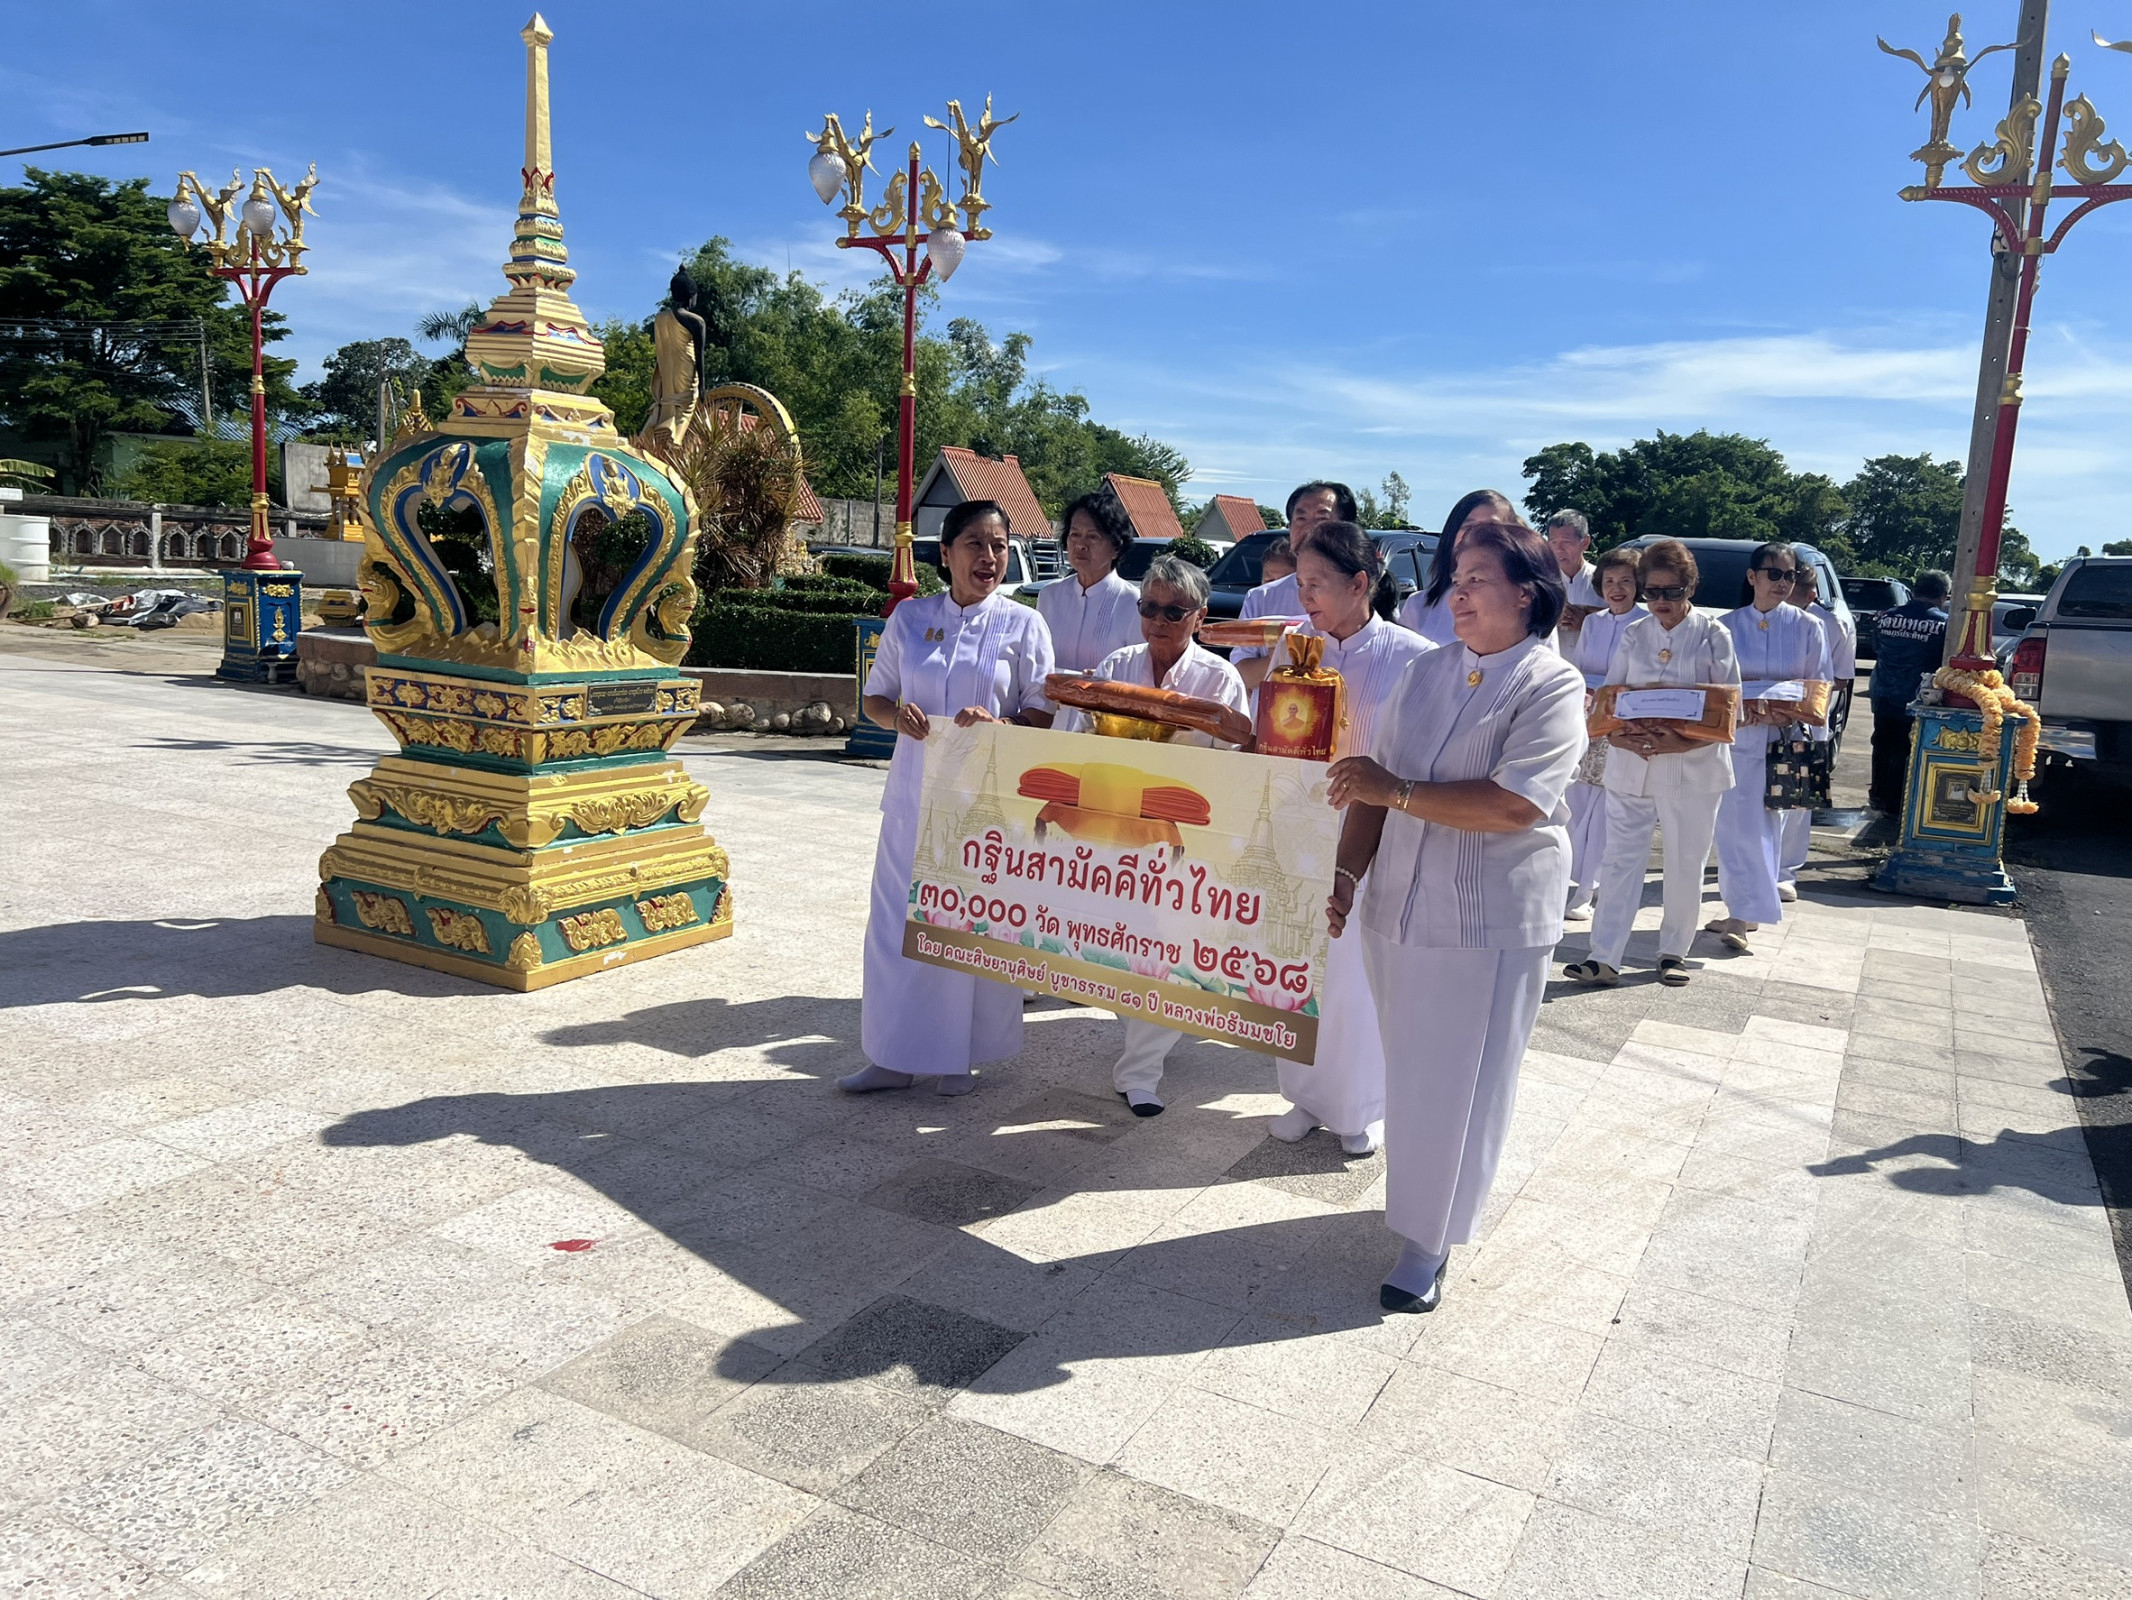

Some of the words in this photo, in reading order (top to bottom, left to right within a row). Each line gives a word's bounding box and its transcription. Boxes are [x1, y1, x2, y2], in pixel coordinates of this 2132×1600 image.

[963, 830, 1260, 925] กฐินสามัคคีทั่วไทย
[917, 935, 941, 954] โดย
[945, 946, 1046, 981] คณะศิษยานุศิษย์
[1051, 973, 1115, 999] บูชาธรรม
[1121, 993, 1141, 1008] ๘๑
[1148, 993, 1158, 1011] ปี
[1164, 1003, 1295, 1047] หลวงพ่อธัมมชโย
[920, 884, 1027, 928] ๓๐,๐๐๐
[1035, 905, 1060, 936] วัด
[1067, 920, 1182, 964] พุทธศักราช
[1193, 939, 1309, 993] ๒๕๖๘
